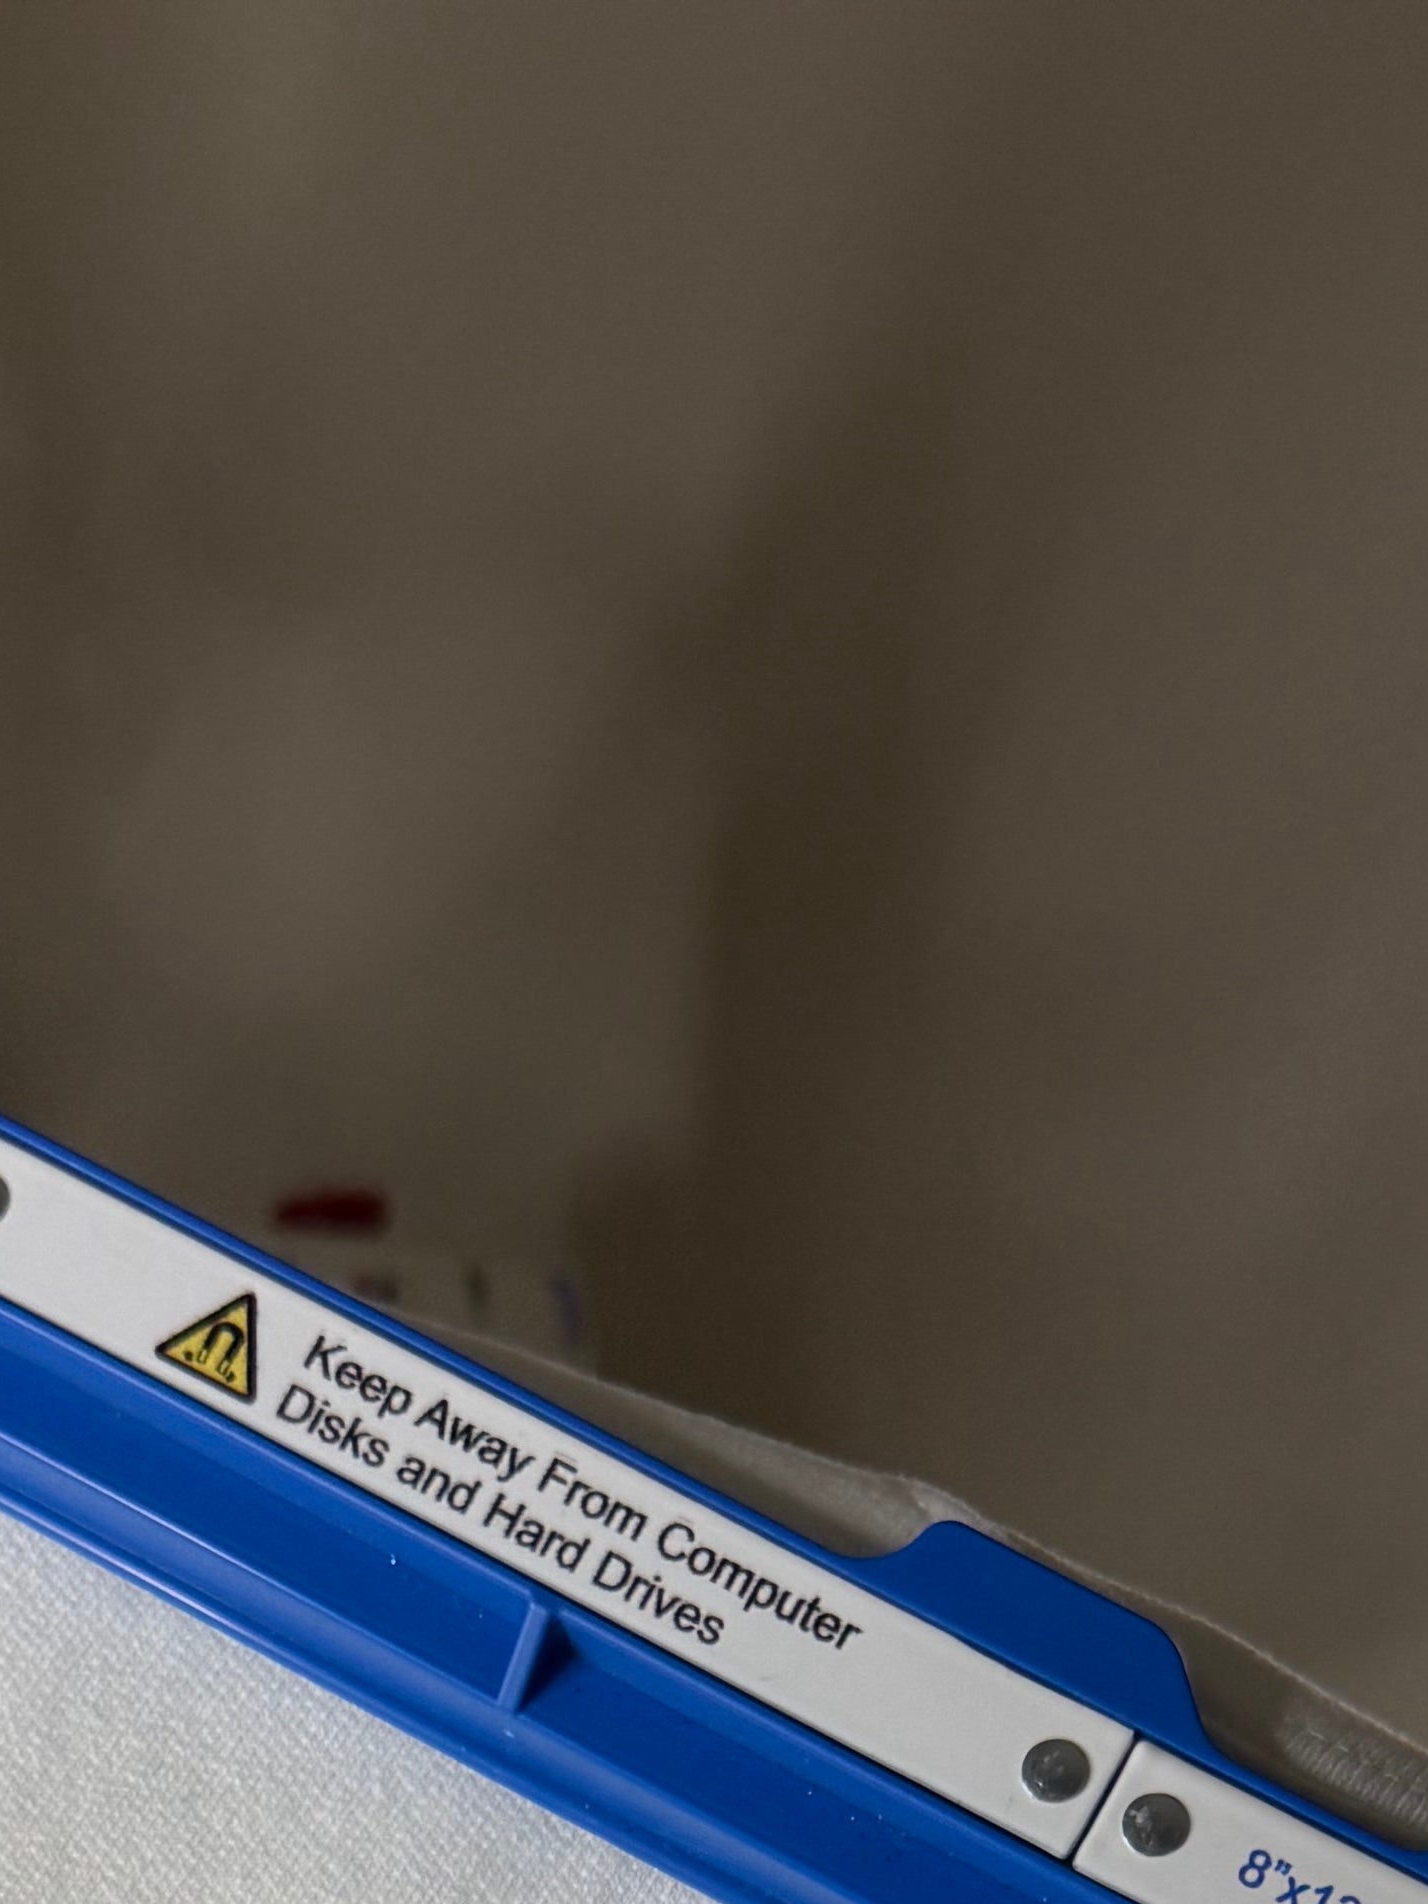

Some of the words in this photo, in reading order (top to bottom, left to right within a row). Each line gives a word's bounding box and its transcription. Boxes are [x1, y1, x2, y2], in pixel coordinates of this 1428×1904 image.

[275, 1383, 390, 1468] Disks
[396, 1453, 482, 1514] and
[483, 1491, 590, 1574] Hard
[592, 1550, 726, 1646] Drives
[303, 1334, 413, 1419] Keep
[414, 1398, 536, 1483] Away
[538, 1457, 649, 1542] From
[658, 1521, 862, 1650] Computer
